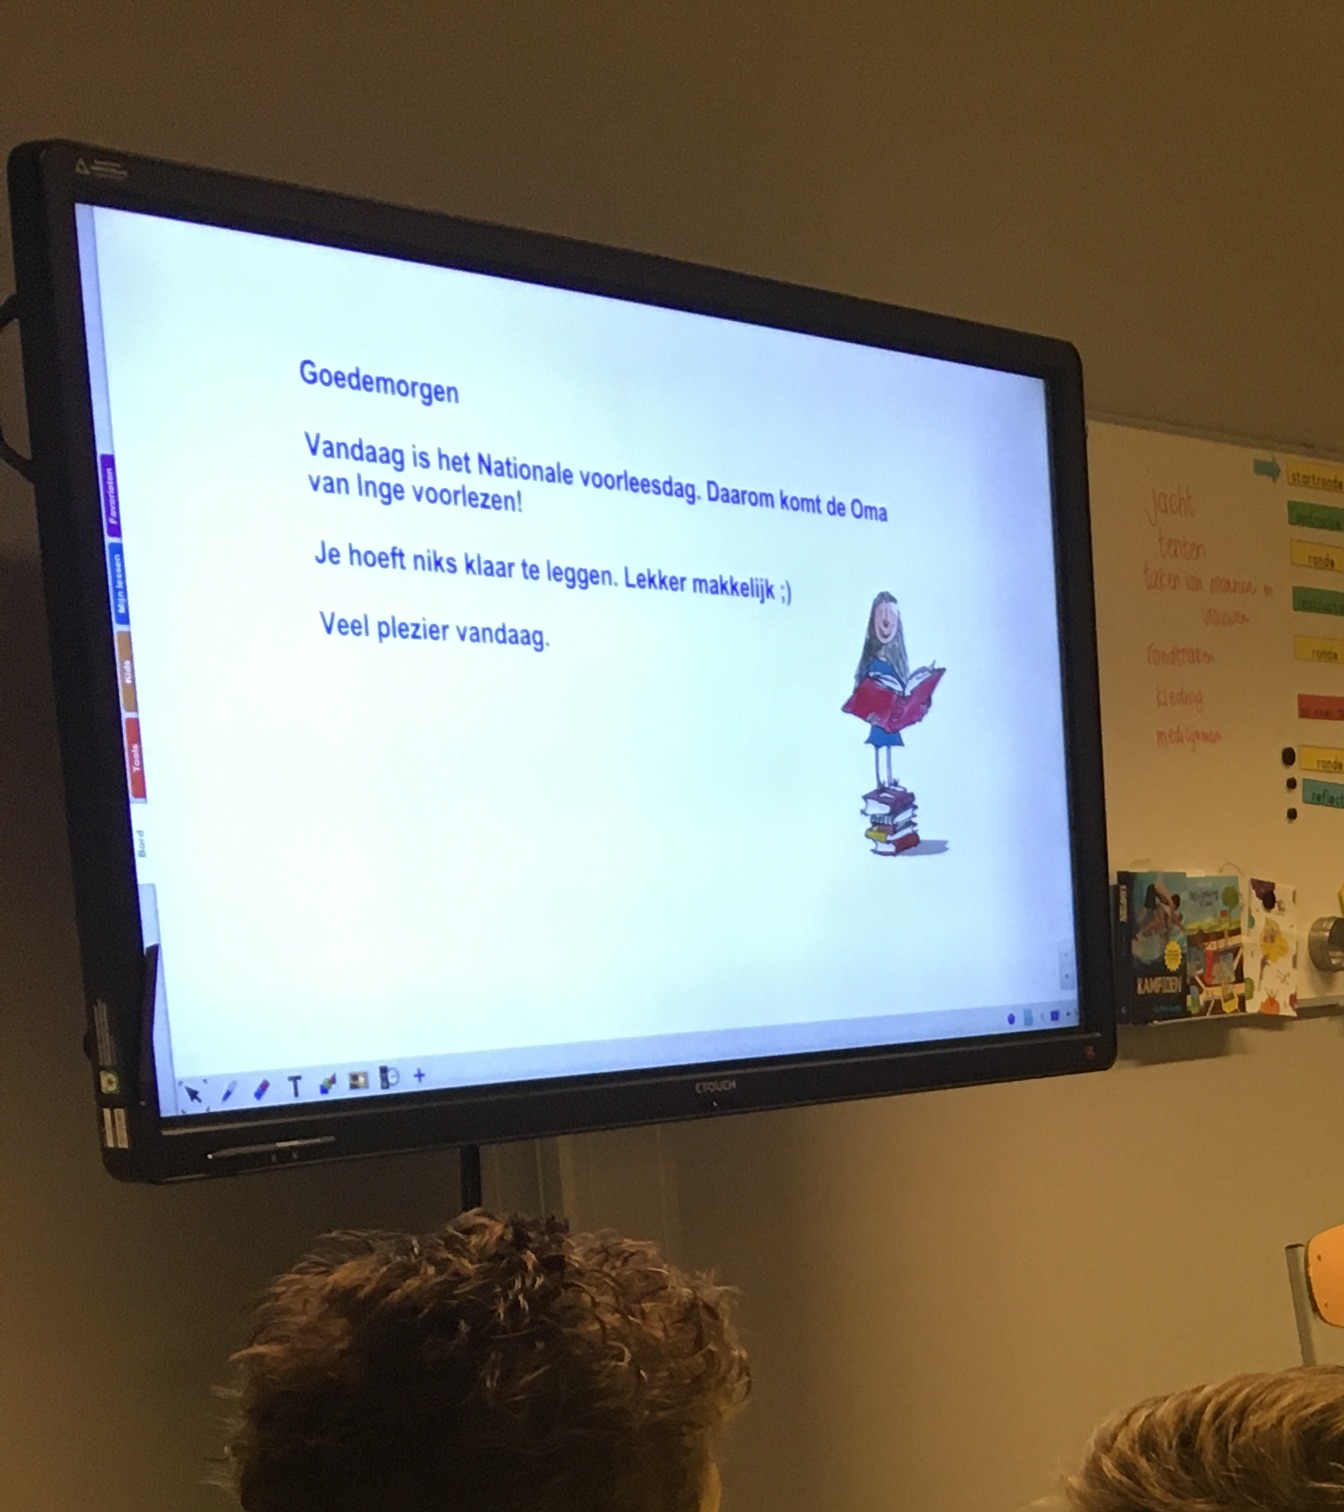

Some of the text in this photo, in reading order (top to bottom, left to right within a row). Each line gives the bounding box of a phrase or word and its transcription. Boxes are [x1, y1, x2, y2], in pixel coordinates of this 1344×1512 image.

[299, 359, 459, 406] Goedemorgen
[304, 431, 888, 522] Vandaag is het Nationale voorleesdag. Daarom komt de Oma
[1291, 471, 1344, 490] startronde
[308, 473, 523, 513] van Inge voorlezen!
[314, 540, 341, 565] Je
[349, 542, 406, 570] hoeft
[413, 549, 458, 575] niks
[464, 552, 515, 578] klaar
[521, 559, 540, 581] te
[547, 559, 618, 590] leggen.
[624, 566, 687, 592] Lekker
[693, 574, 775, 604] makkelijk
[1308, 551, 1336, 569] ronde
[319, 611, 550, 653] Veel plezier vandaag.
[1311, 645, 1339, 661] ronde
[124, 659, 134, 684] Kids
[132, 743, 141, 773] Tools
[1316, 755, 1343, 771] ronde
[136, 829, 147, 858] Bord
